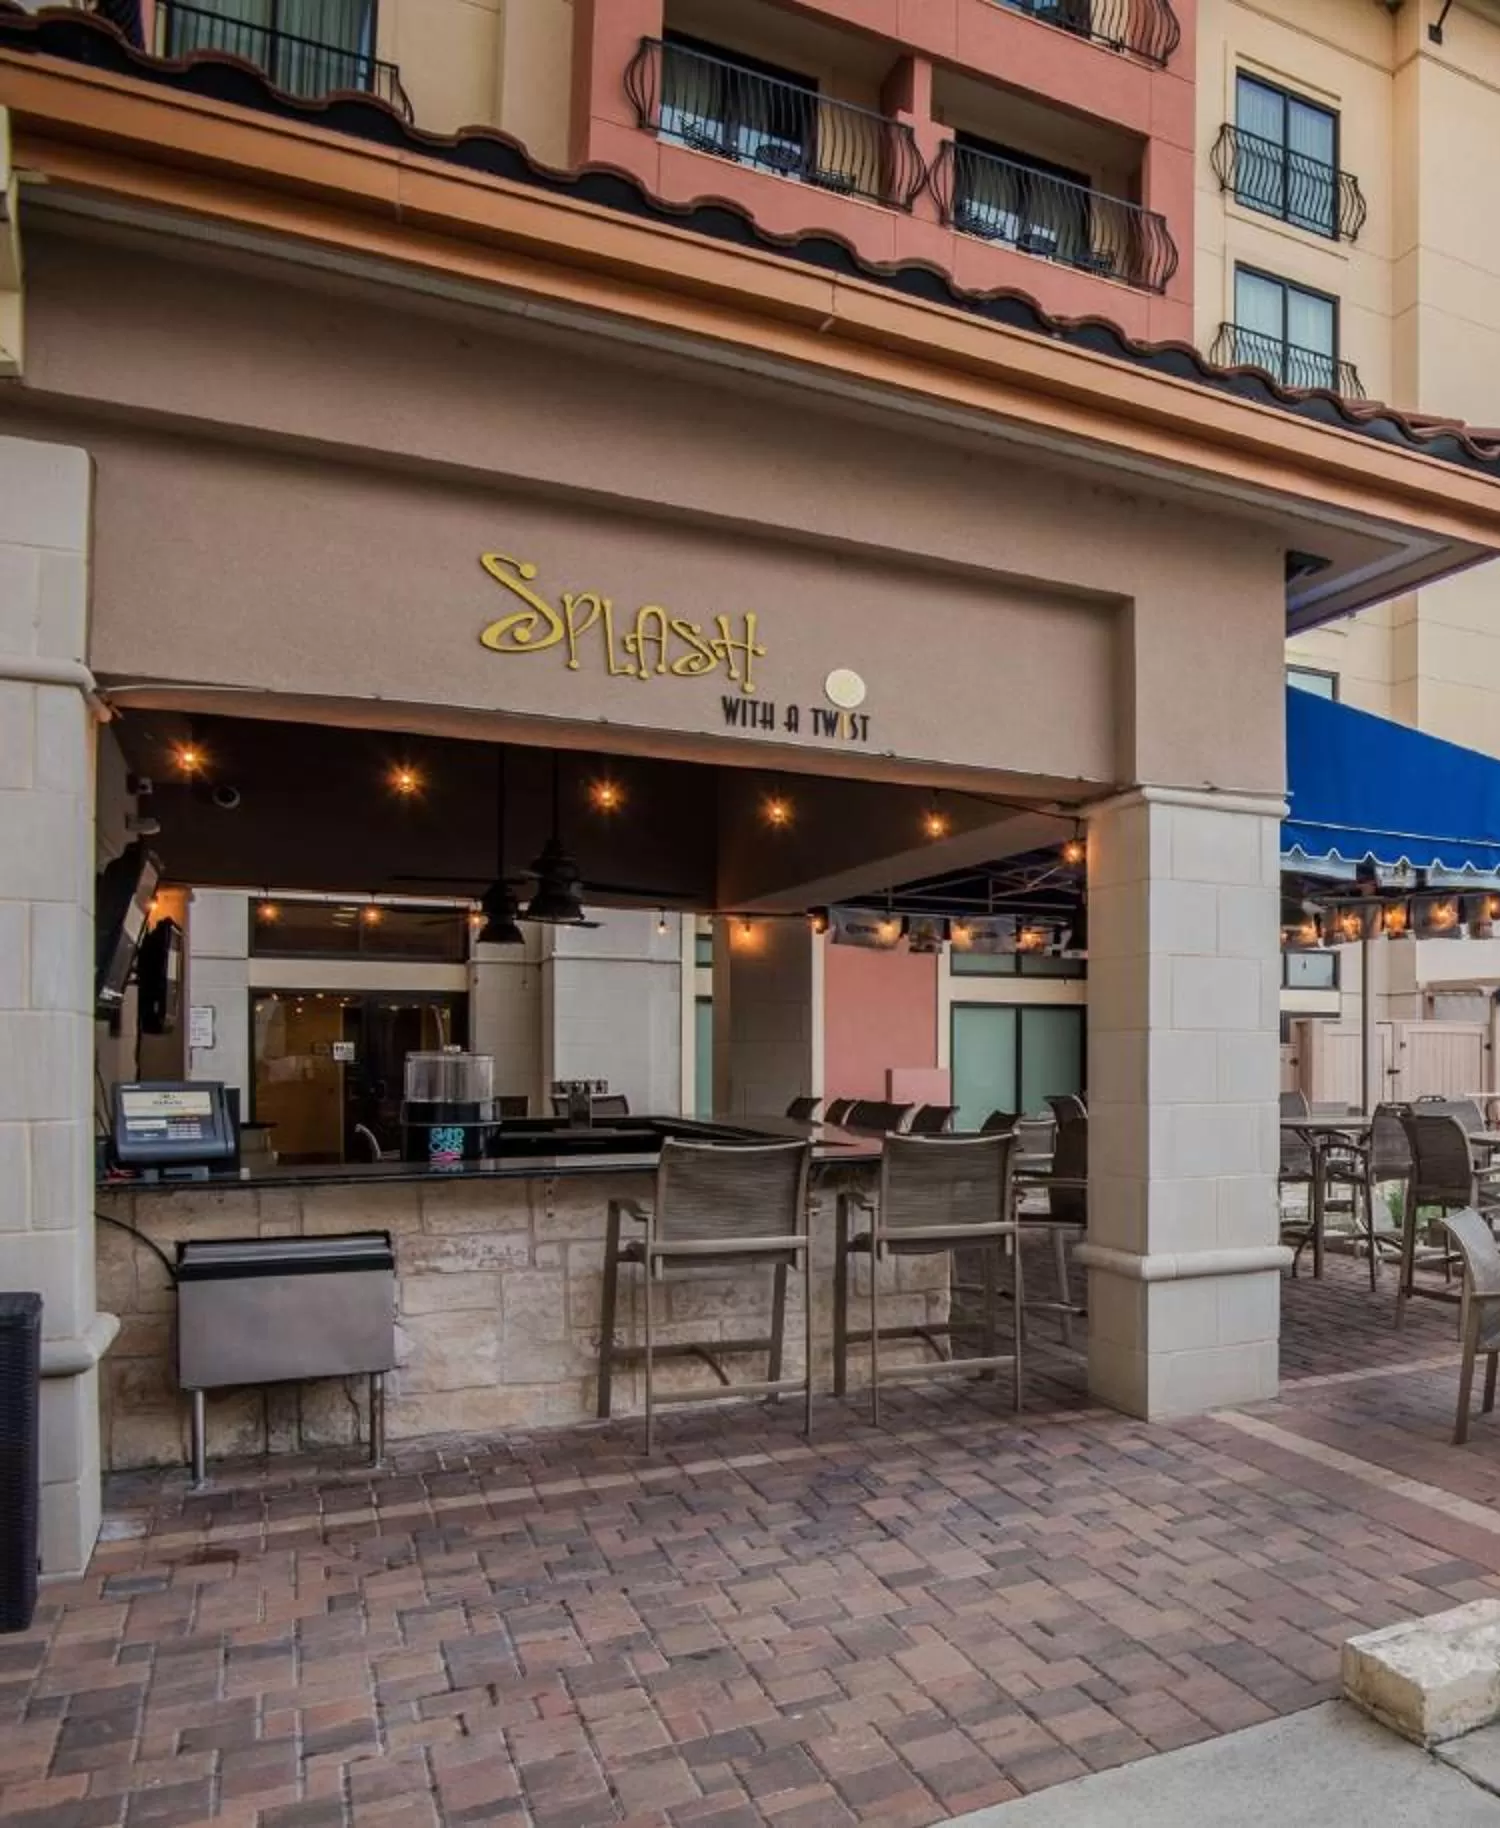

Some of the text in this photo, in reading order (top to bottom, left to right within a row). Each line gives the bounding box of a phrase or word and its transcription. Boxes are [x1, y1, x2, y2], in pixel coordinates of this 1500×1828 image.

[721, 696, 870, 741] WITH A TWIST
